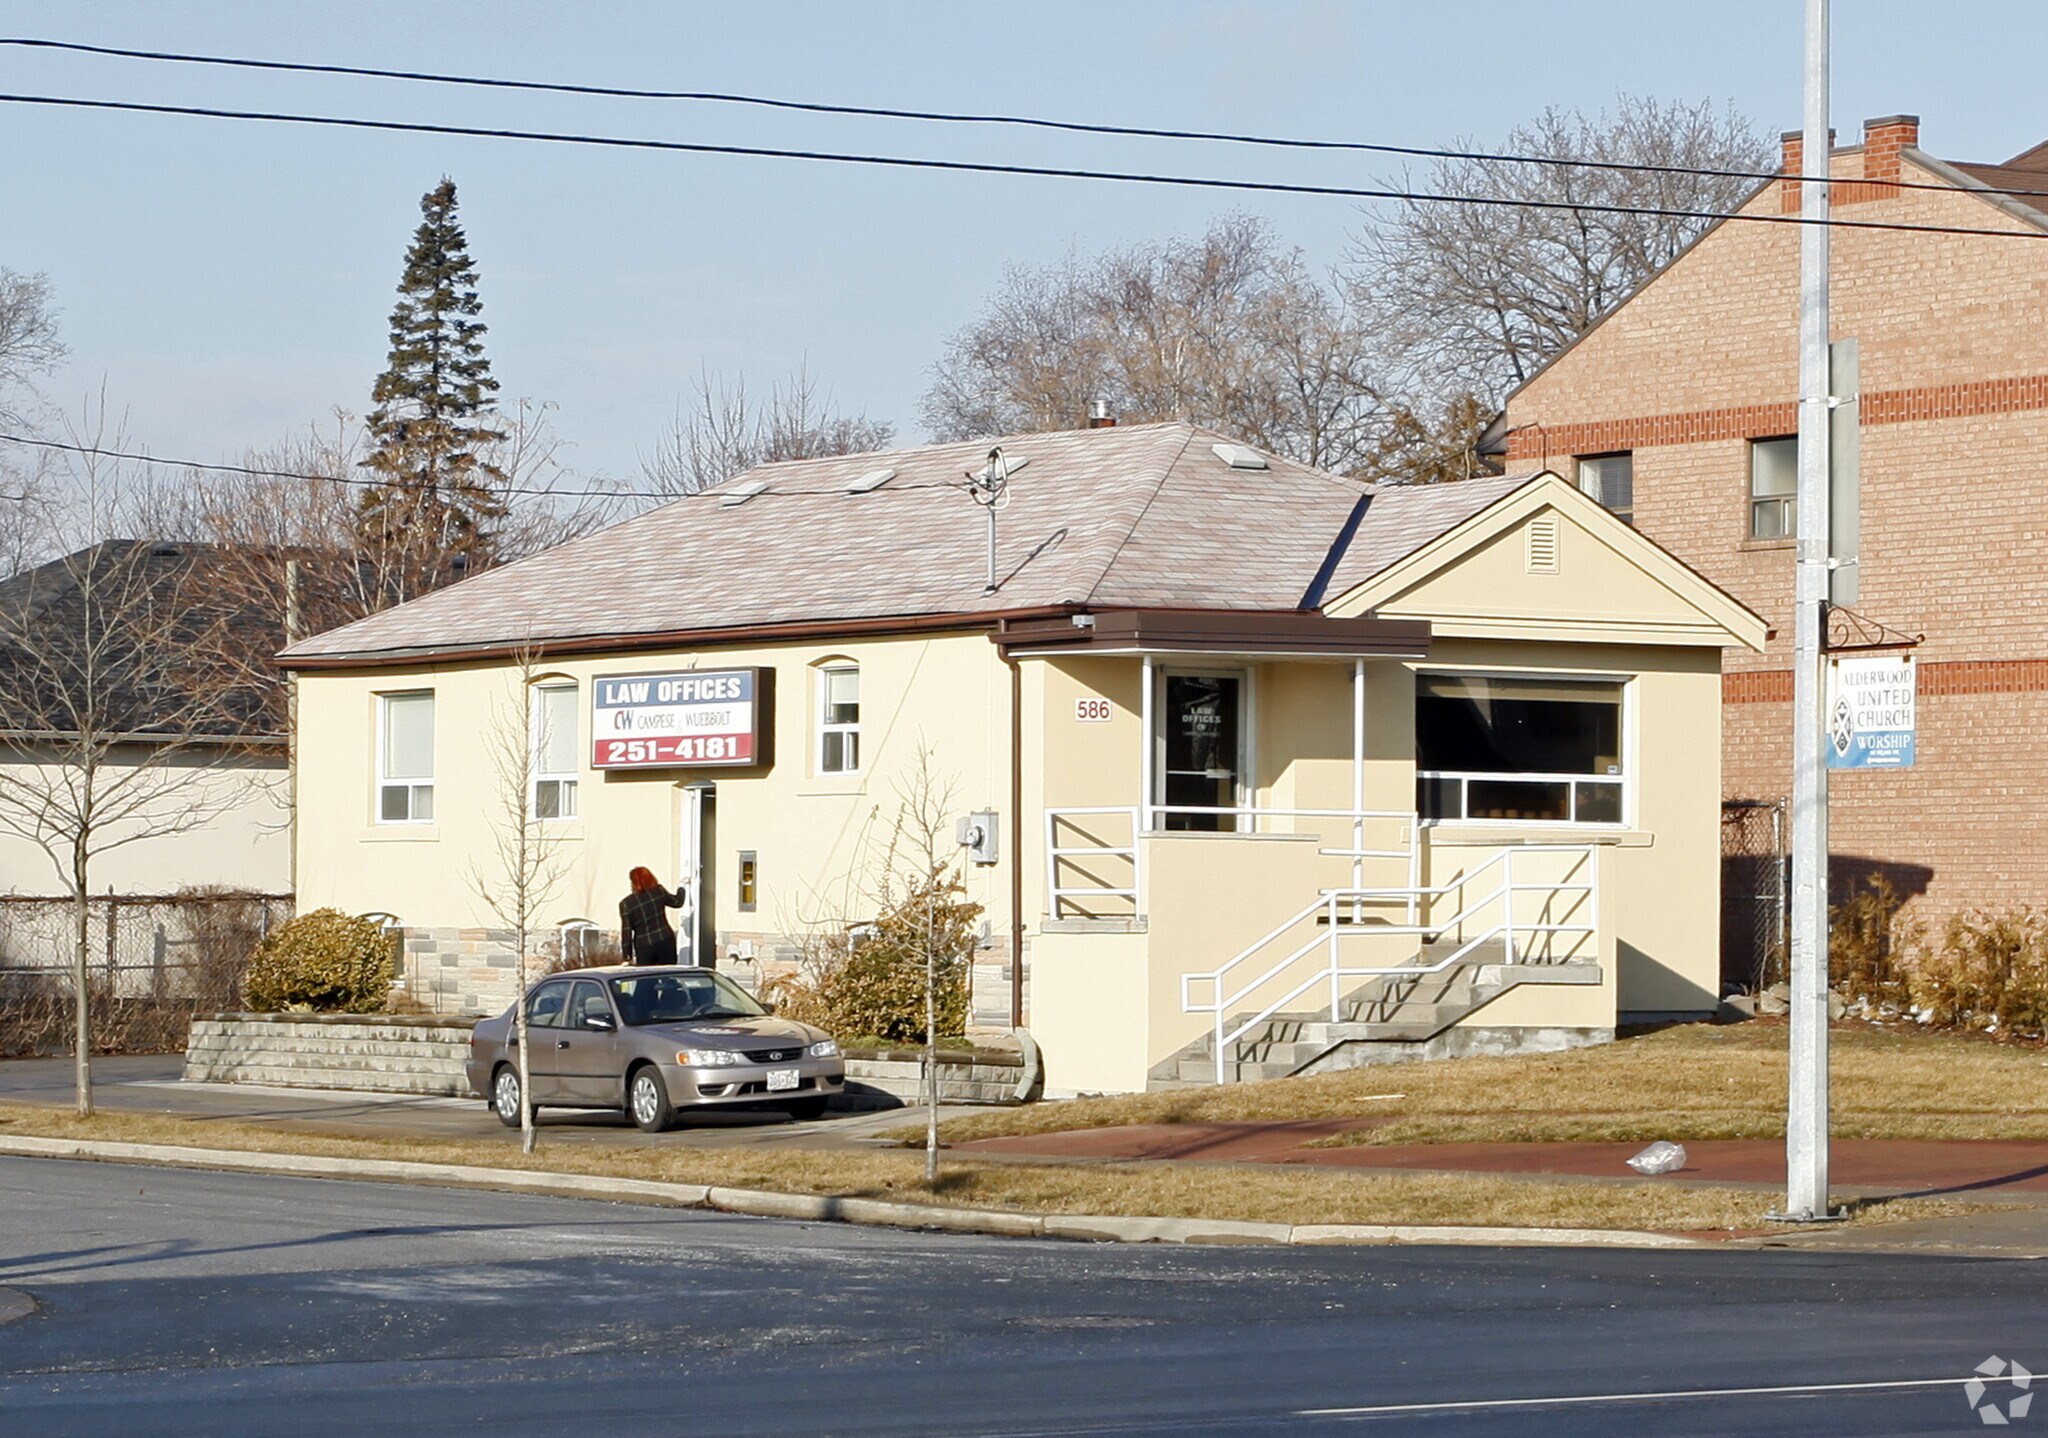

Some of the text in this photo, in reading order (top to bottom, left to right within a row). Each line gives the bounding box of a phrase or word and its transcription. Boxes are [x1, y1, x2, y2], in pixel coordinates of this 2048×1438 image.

[1844, 669, 1911, 686] ALDERWOOD
[606, 677, 741, 704] LAW OFFICES
[1858, 689, 1911, 706] UNITED
[1078, 701, 1109, 719] 586
[1191, 707, 1212, 715] LAW
[1857, 709, 1910, 726] CHURCH
[637, 714, 675, 729] CAMPESE
[686, 711, 731, 727] WUEBBOLT
[1182, 715, 1222, 723] OFFICES
[608, 736, 737, 762] 251-4181
[1857, 734, 1911, 750] WORSHIP
